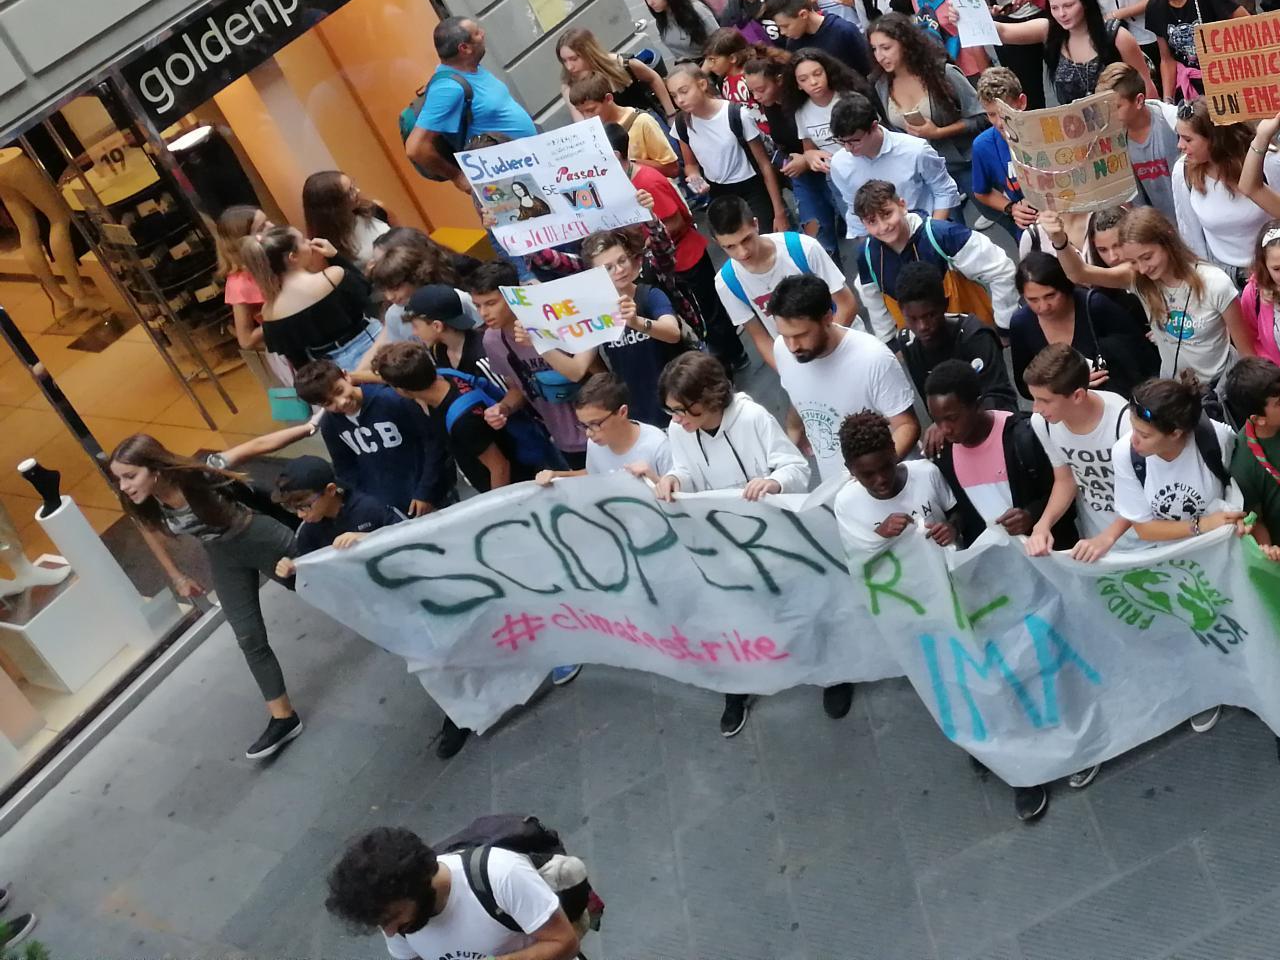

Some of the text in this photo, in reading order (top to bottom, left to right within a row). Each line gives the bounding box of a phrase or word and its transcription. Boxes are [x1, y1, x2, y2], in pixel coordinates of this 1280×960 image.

[462, 152, 541, 181] Studierei
[556, 166, 608, 183] Passato
[542, 299, 579, 323] ARE
[558, 311, 628, 341] FUTURE
[1060, 446, 1112, 463] YOU
